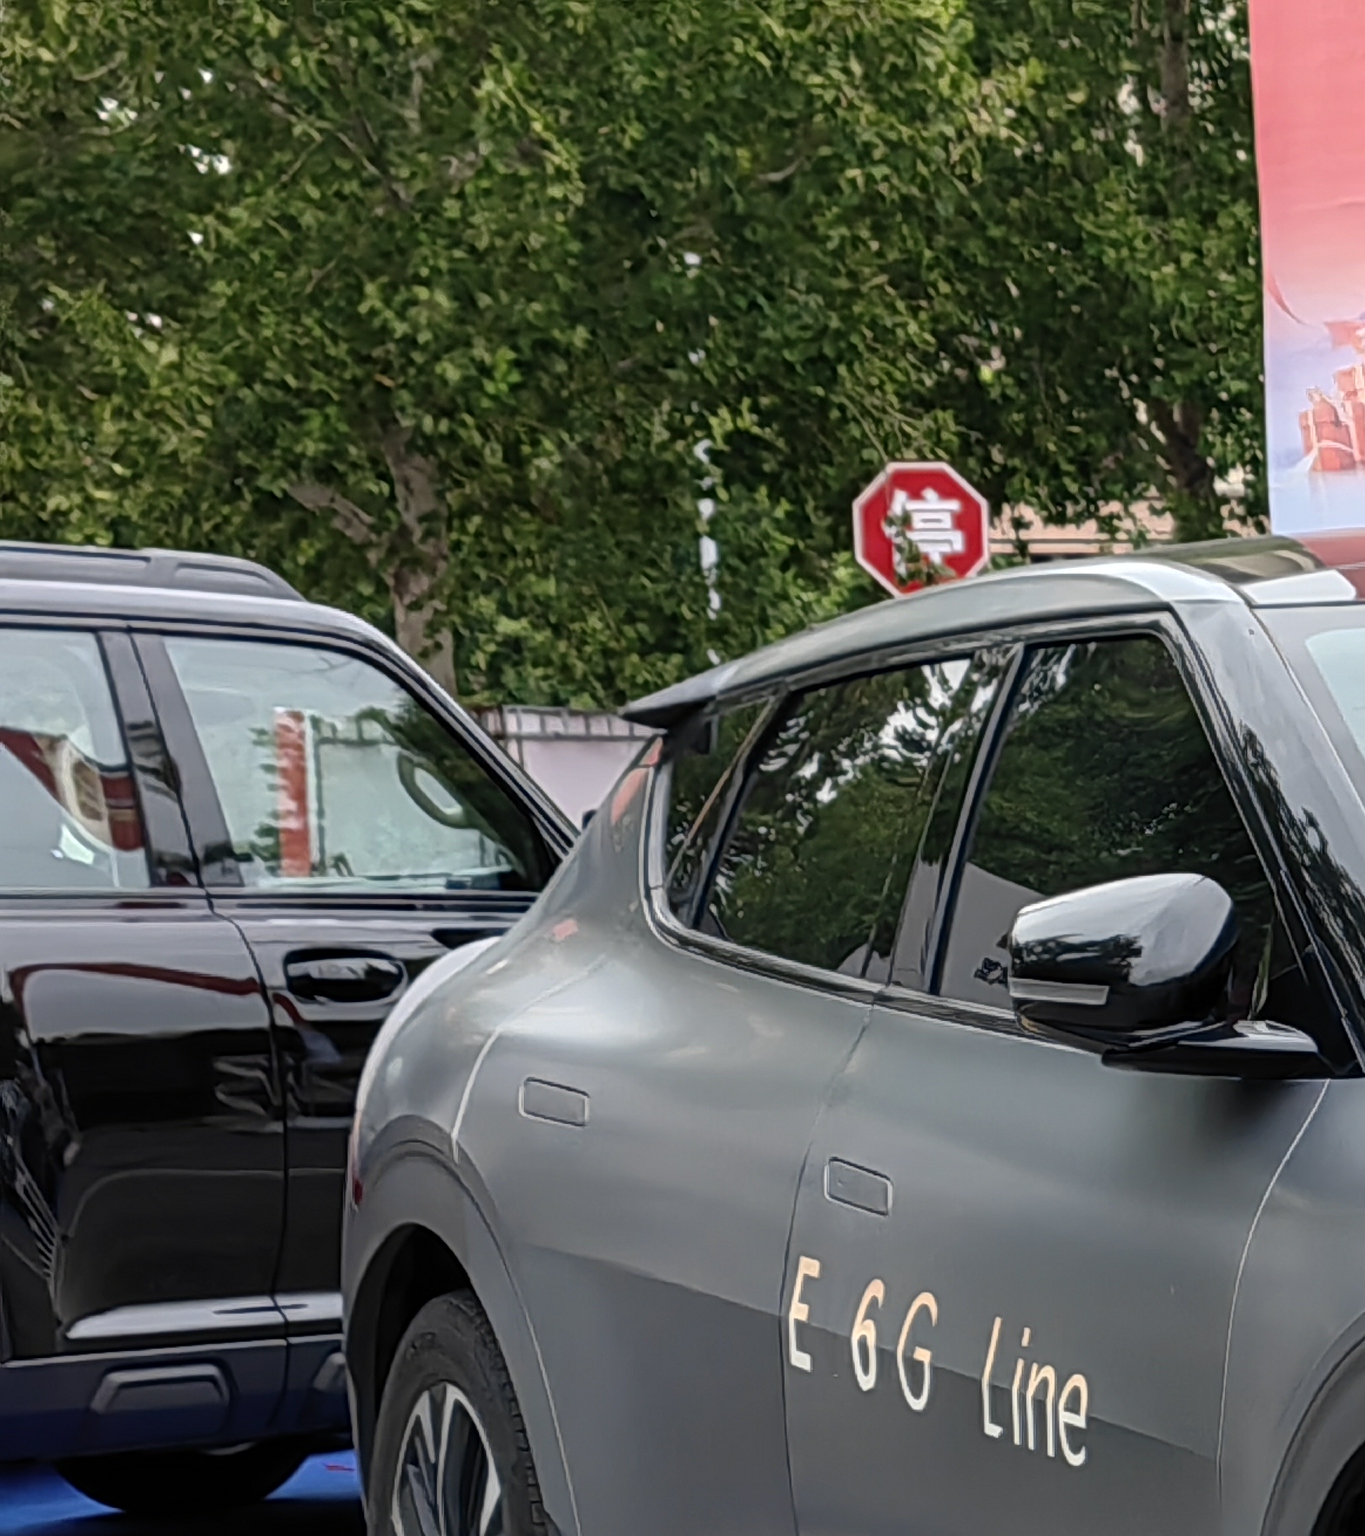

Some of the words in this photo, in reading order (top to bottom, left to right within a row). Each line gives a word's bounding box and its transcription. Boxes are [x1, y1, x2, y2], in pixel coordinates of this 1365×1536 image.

[882, 488, 965, 580] 停
[788, 1255, 821, 1373] E
[980, 1316, 1089, 1467] Line
